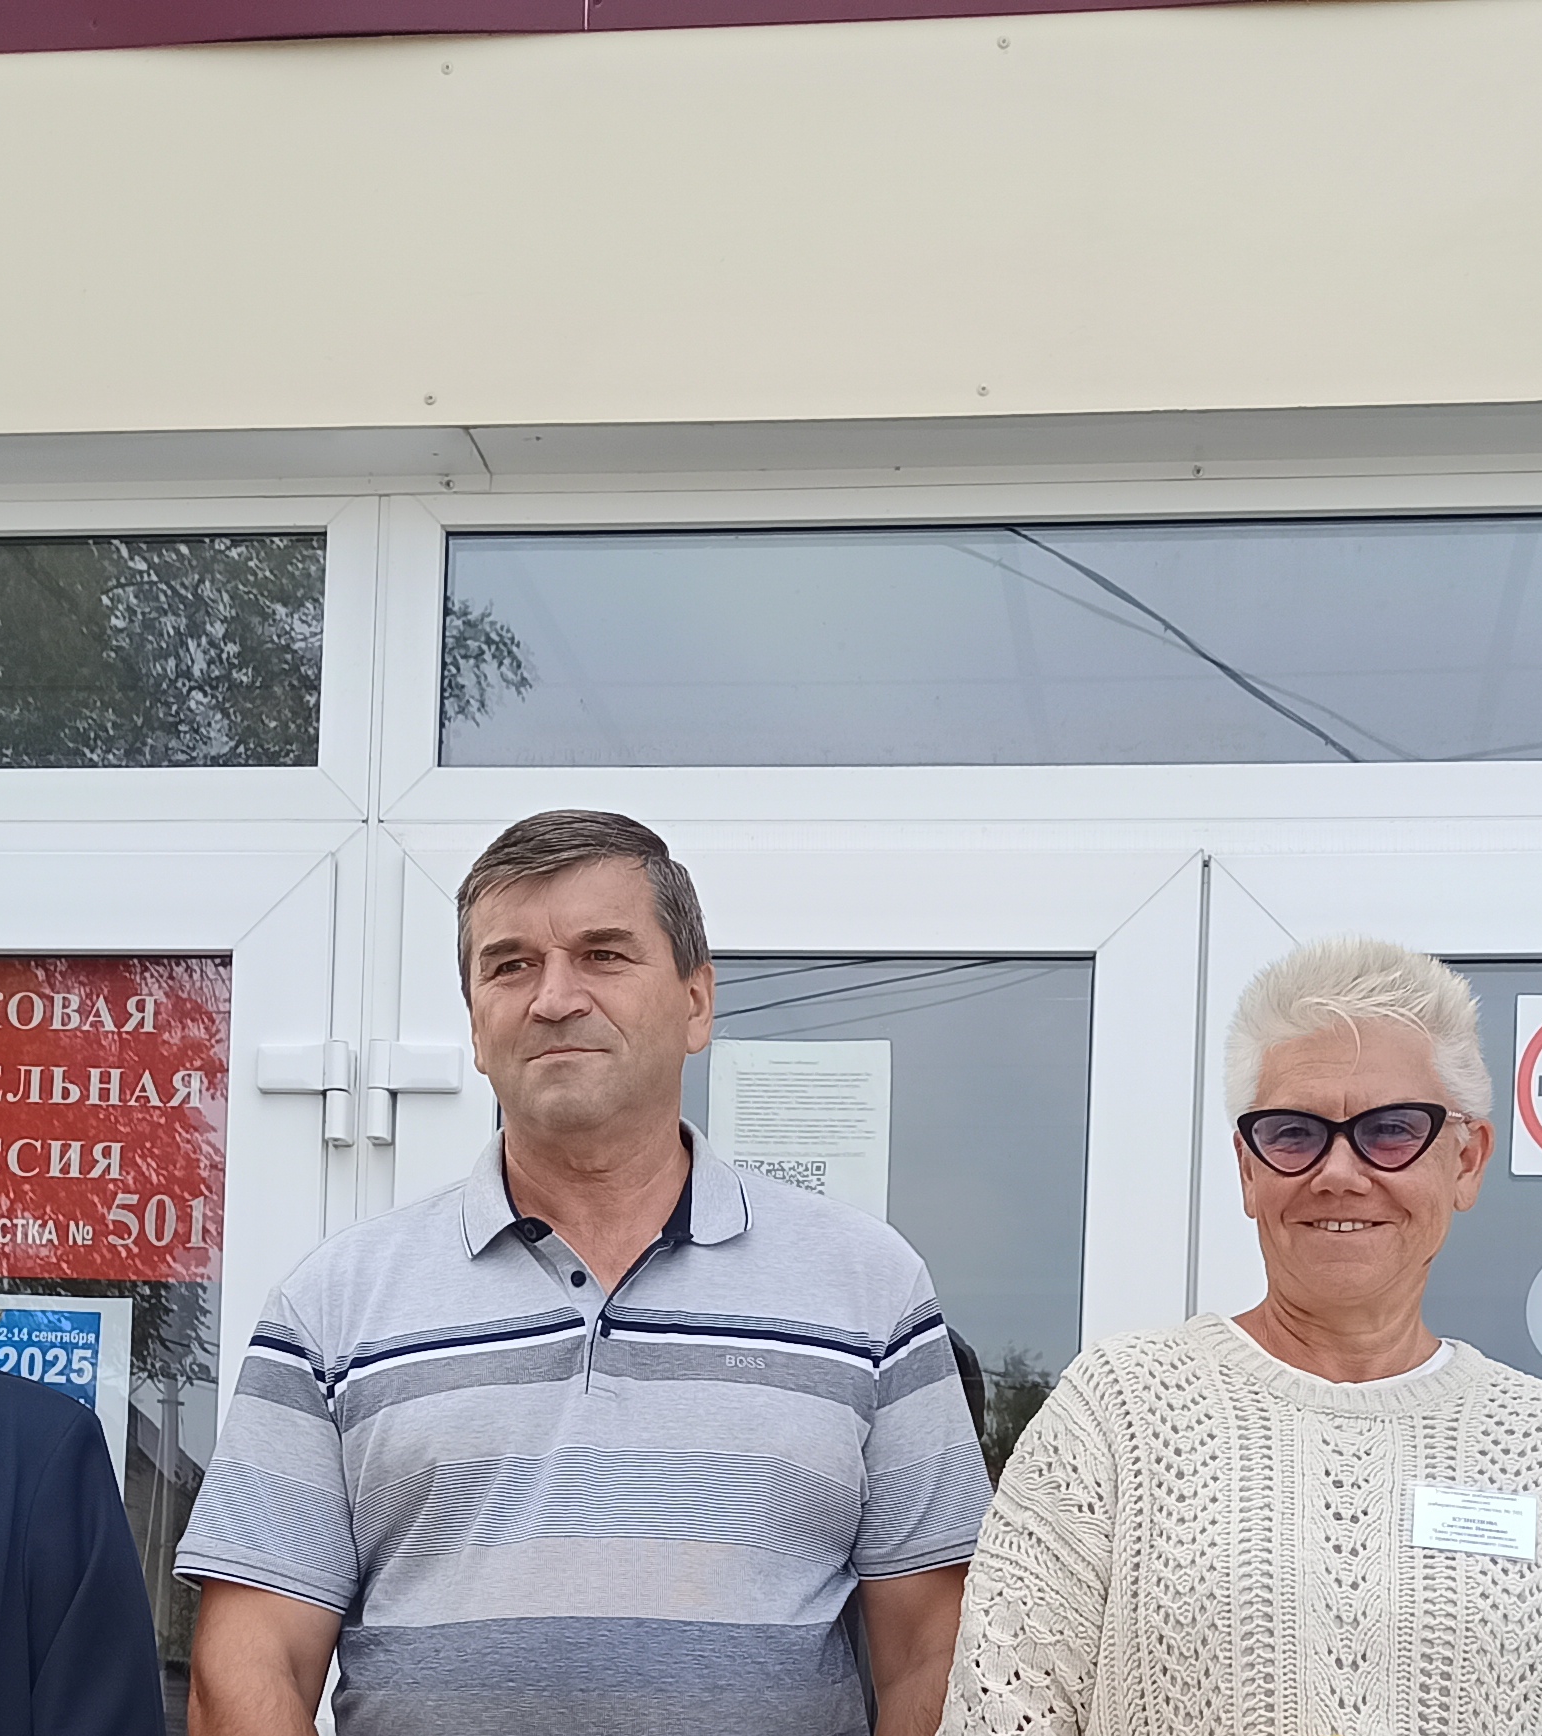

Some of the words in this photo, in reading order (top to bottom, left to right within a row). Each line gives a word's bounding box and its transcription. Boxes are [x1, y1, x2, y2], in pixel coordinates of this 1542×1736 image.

[68, 1221, 93, 1246] №
[108, 1194, 207, 1249] 501
[31, 1330, 96, 1346] сентября
[725, 1354, 766, 1369] BOSS
